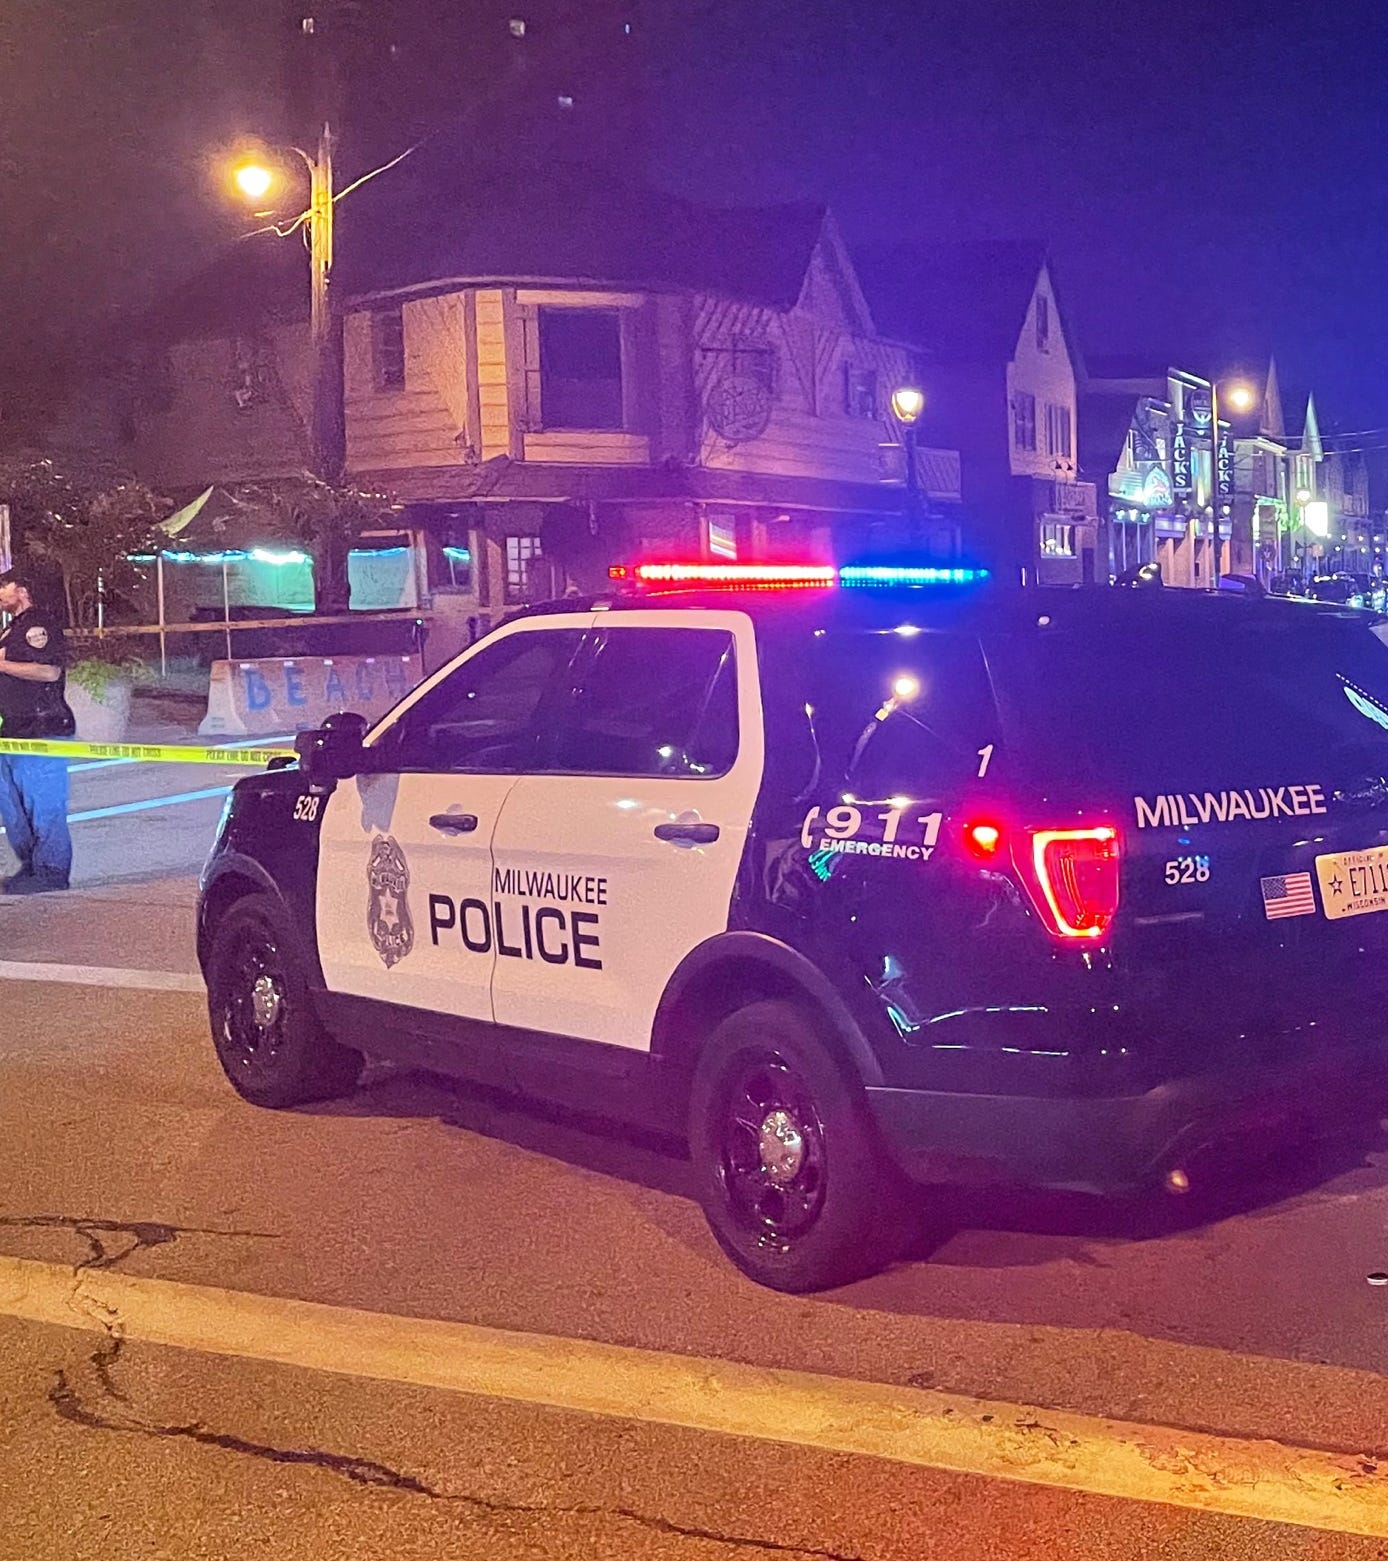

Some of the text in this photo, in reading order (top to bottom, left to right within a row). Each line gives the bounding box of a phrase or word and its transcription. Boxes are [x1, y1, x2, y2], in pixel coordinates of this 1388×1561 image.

[977, 744, 994, 777] 1
[293, 796, 320, 822] 528
[1134, 784, 1327, 828] MILWAUKEE
[824, 805, 942, 846] 911
[820, 838, 935, 861] EMERGENCY
[495, 867, 607, 905] MILWAUKEE
[1164, 857, 1210, 885] 528
[428, 893, 603, 970] POLICE
